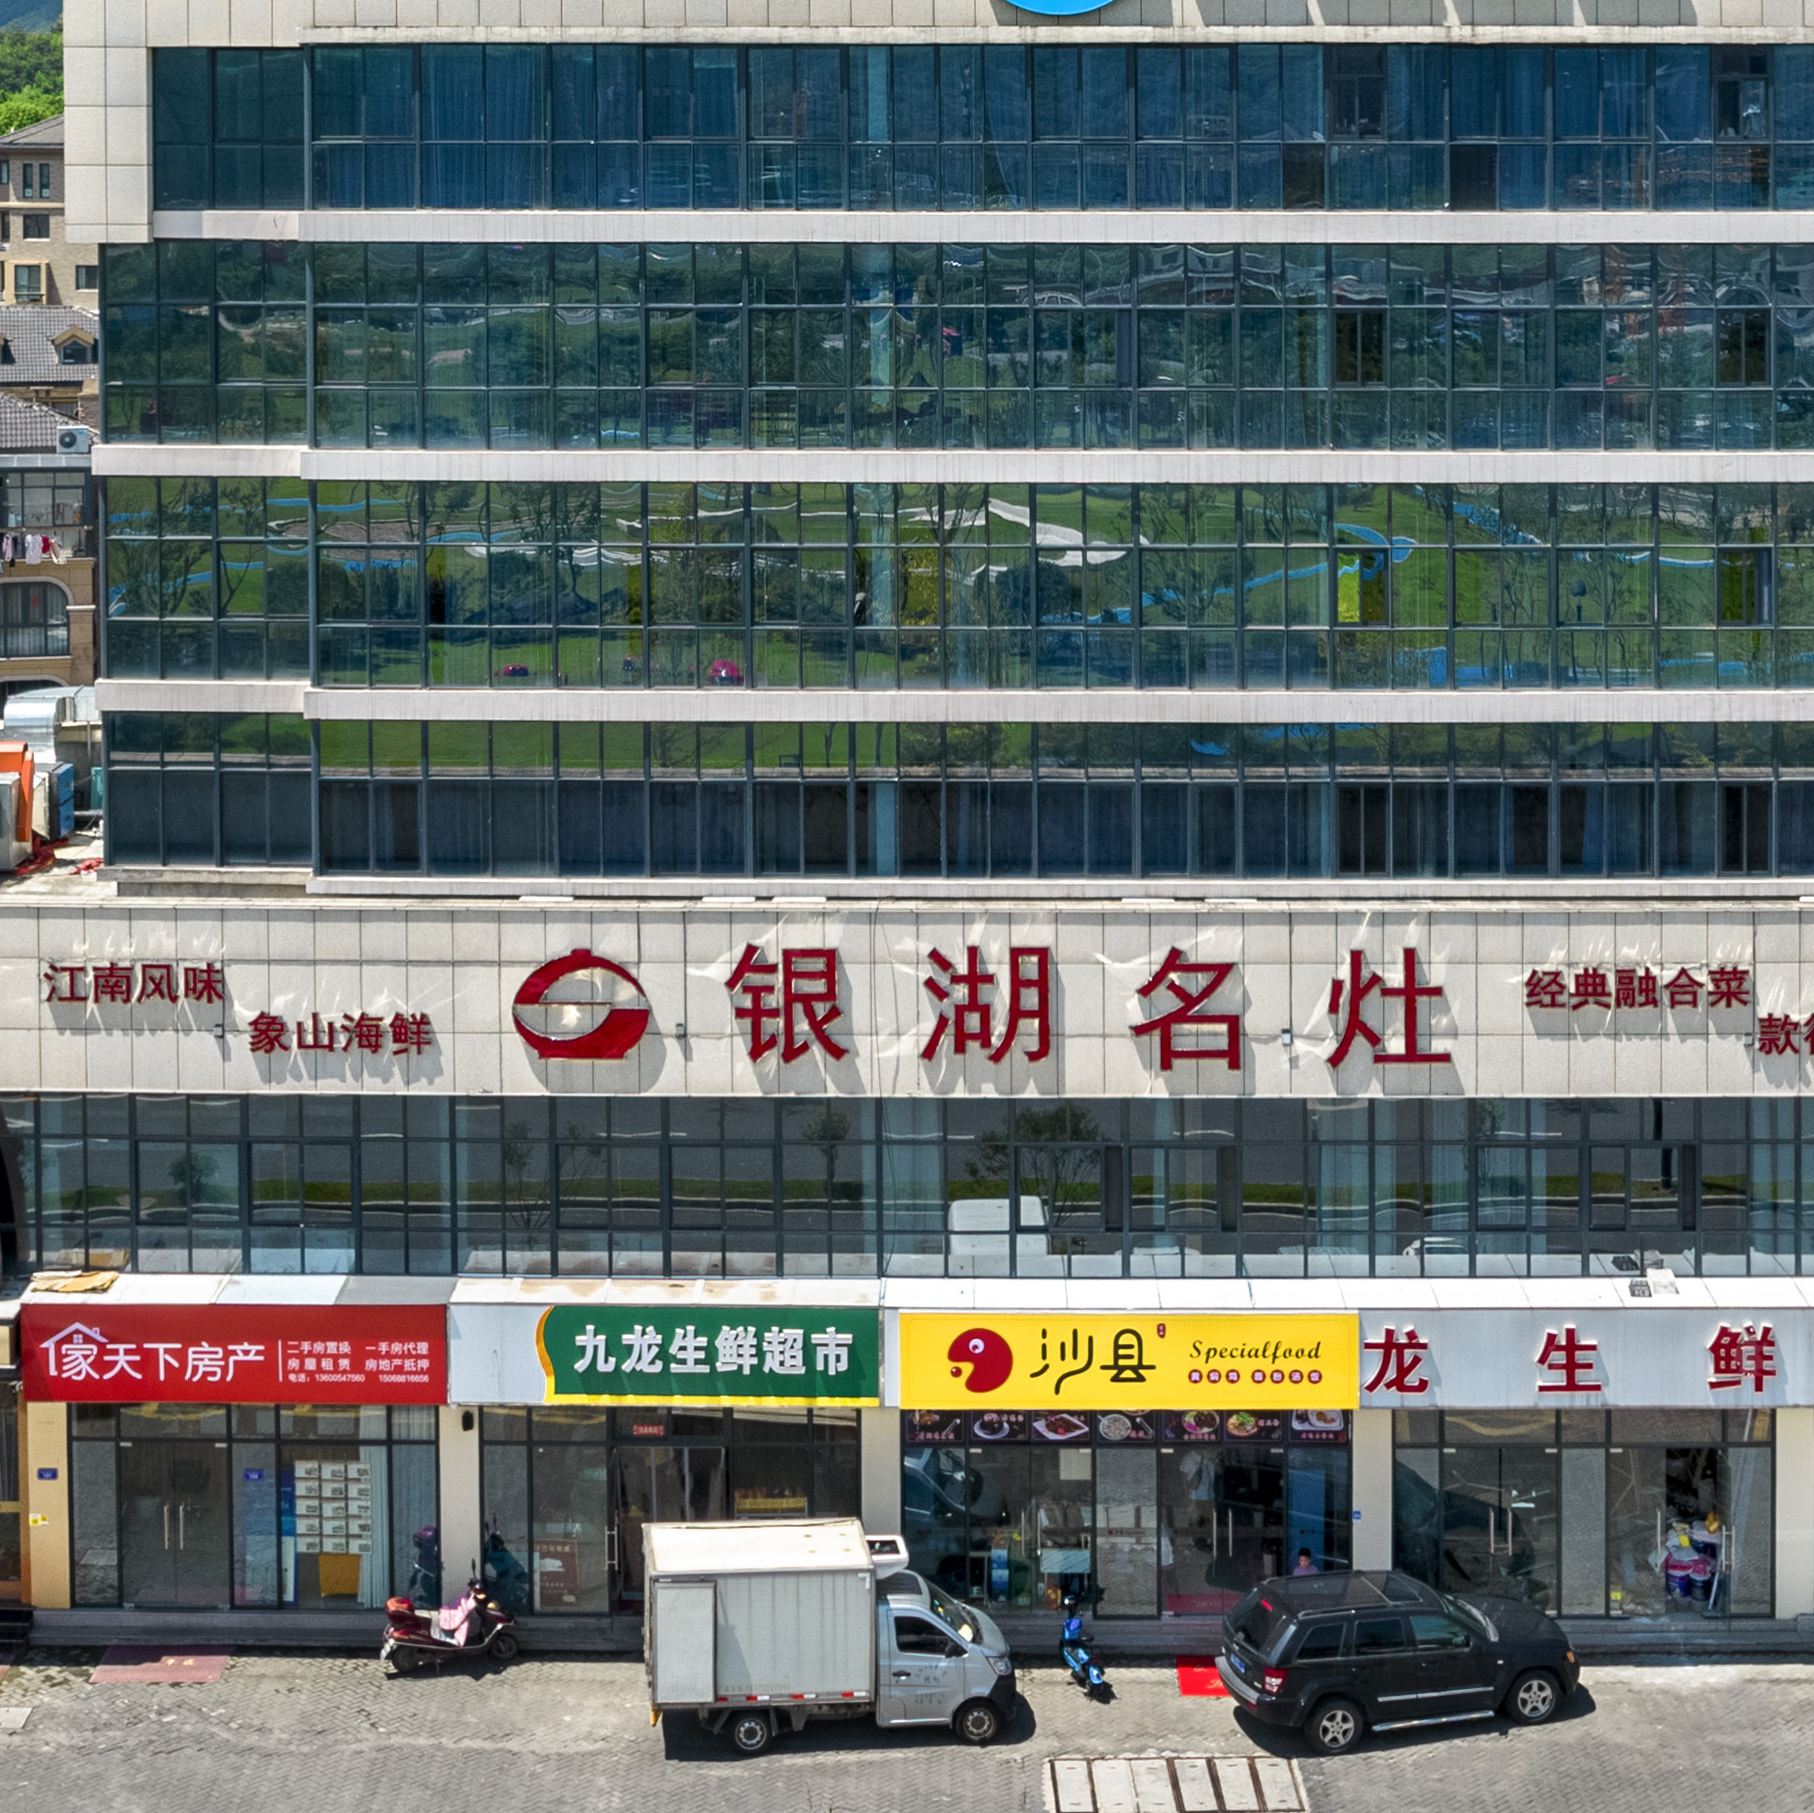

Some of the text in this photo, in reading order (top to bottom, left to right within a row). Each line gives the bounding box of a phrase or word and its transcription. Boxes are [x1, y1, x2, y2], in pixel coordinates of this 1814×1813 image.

[43, 962, 225, 1005] 江南风味
[1524, 967, 1750, 1010] 经典融合菜
[725, 943, 1452, 1071] 银湖名灶
[248, 1010, 433, 1056] 象山海鲜
[61, 1341, 266, 1382] 家天下房产
[287, 1341, 429, 1355] 二手房置换 一手房代理
[287, 1358, 430, 1372] 房屋租赁 房地产抵押
[573, 1325, 853, 1375] 九龙生鲜超市
[1029, 1327, 1157, 1395] 沙县
[1189, 1339, 1322, 1364] Specialfood
